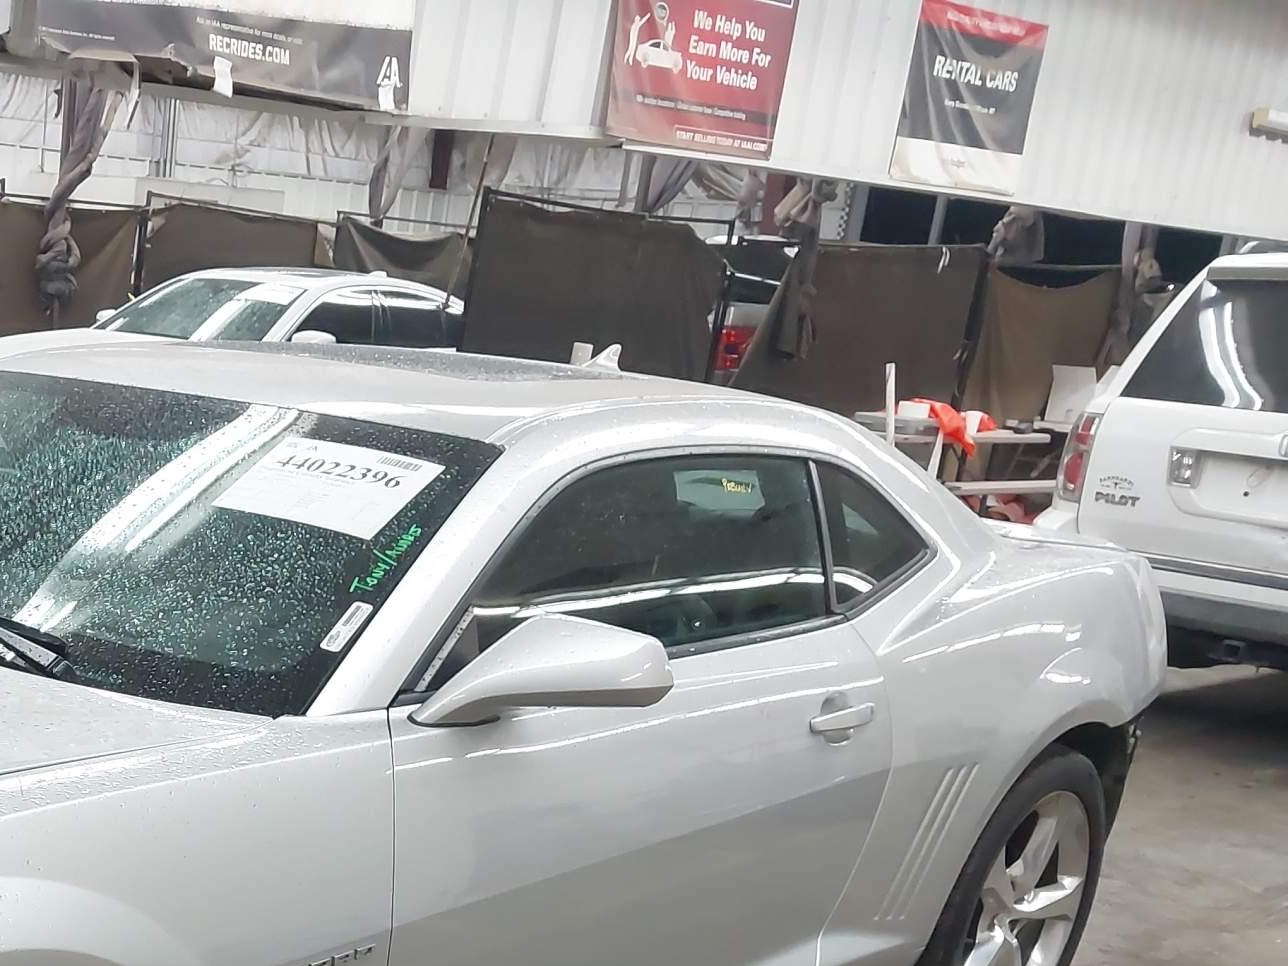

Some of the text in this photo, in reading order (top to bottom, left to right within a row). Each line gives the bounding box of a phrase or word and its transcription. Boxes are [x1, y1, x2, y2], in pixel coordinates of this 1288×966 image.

[693, 9, 766, 42] We Help You
[209, 34, 290, 65] RECRIDES.COM
[688, 35, 771, 68] Earn More For
[686, 59, 758, 91] Your Vehicle
[933, 55, 1018, 92] RENTAL CARS
[276, 455, 408, 488] 44022396
[1095, 491, 1141, 507] PILOT
